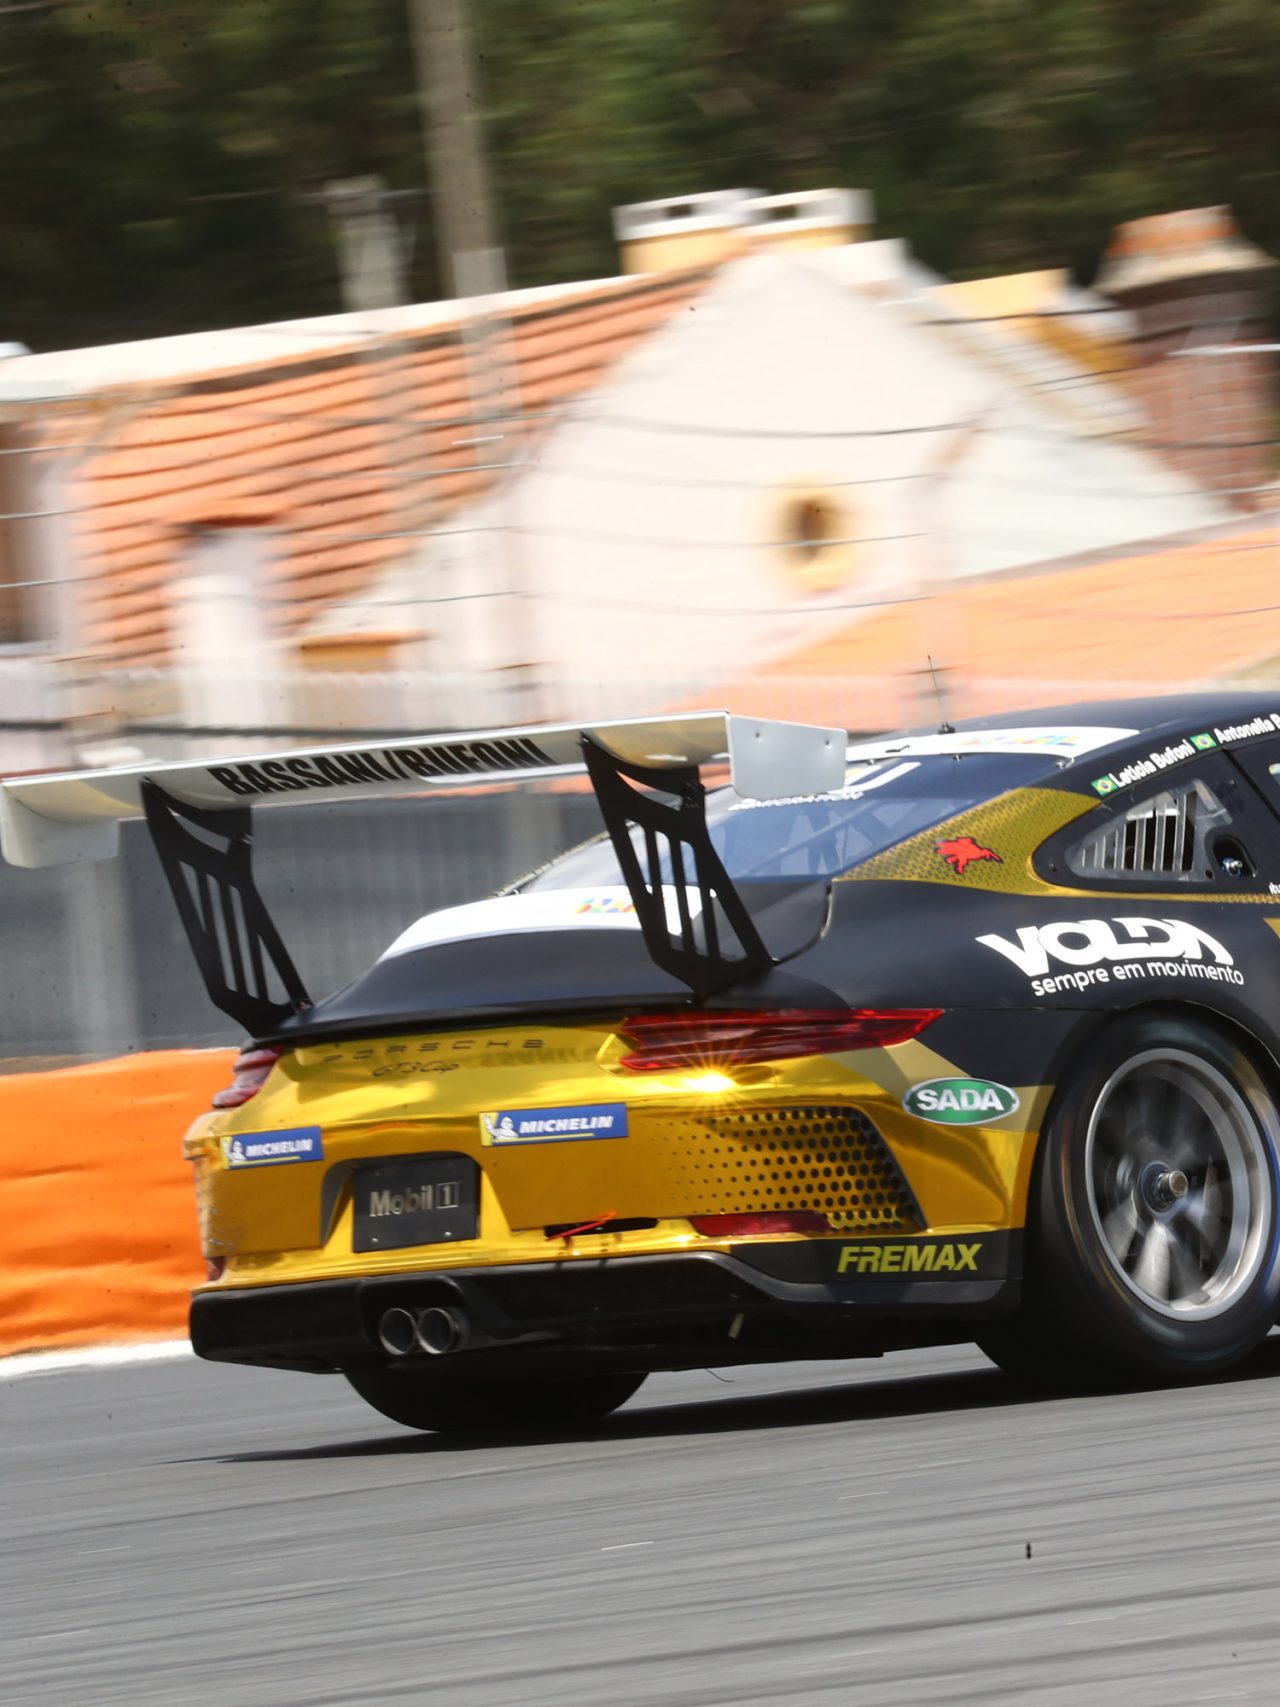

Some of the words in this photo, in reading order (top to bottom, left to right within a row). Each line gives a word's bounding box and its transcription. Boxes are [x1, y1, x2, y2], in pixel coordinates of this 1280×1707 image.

[1213, 717, 1275, 744] Antonella
[206, 738, 559, 795] BASSANI/BUFONI
[1150, 739, 1196, 770] Bufoni
[1031, 967, 1110, 997] sempre
[1115, 961, 1147, 980] em
[1149, 958, 1245, 986] movimento
[916, 1088, 1004, 1112] SADA
[518, 1115, 613, 1135] MICHELIN
[245, 1138, 313, 1158] MICHELIN
[369, 1183, 434, 1217] Mobil
[836, 1243, 983, 1273] FREMAX
